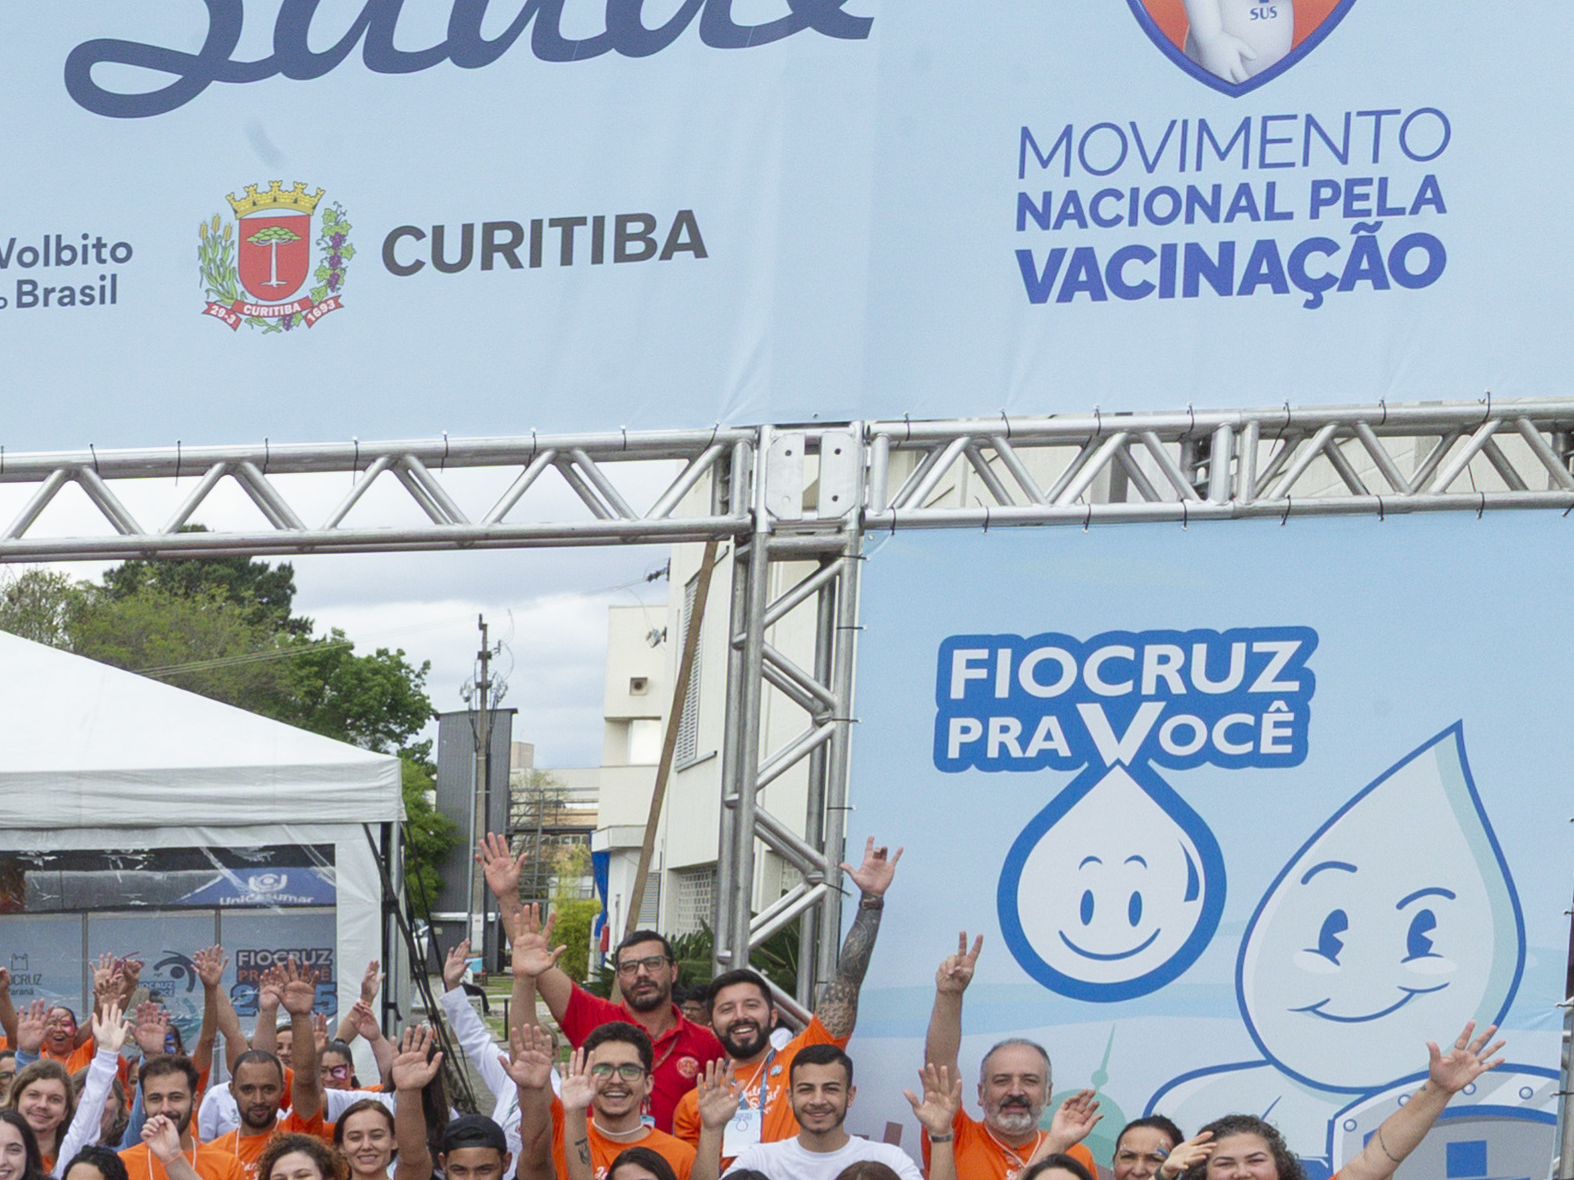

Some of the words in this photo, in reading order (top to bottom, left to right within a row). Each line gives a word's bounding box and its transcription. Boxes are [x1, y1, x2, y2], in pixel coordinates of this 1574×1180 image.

[1250, 6, 1277, 20] SUS
[1018, 107, 1451, 179] MOVIMENTO
[1016, 183, 1293, 231] NACIONAL
[1309, 175, 1447, 219] PELA
[382, 210, 709, 277] CURITIBA
[1015, 221, 1447, 309] VACINAÇÃO
[16, 274, 117, 309] Brasil
[243, 303, 302, 316] CURITIBA
[306, 299, 336, 322] 1693
[210, 305, 237, 325] 29-3
[949, 640, 1302, 700] FIOCRUZ
[947, 715, 1071, 760] PRA
[1076, 701, 1295, 768] VOCÊ
[238, 950, 332, 966] FIOCRUZ
